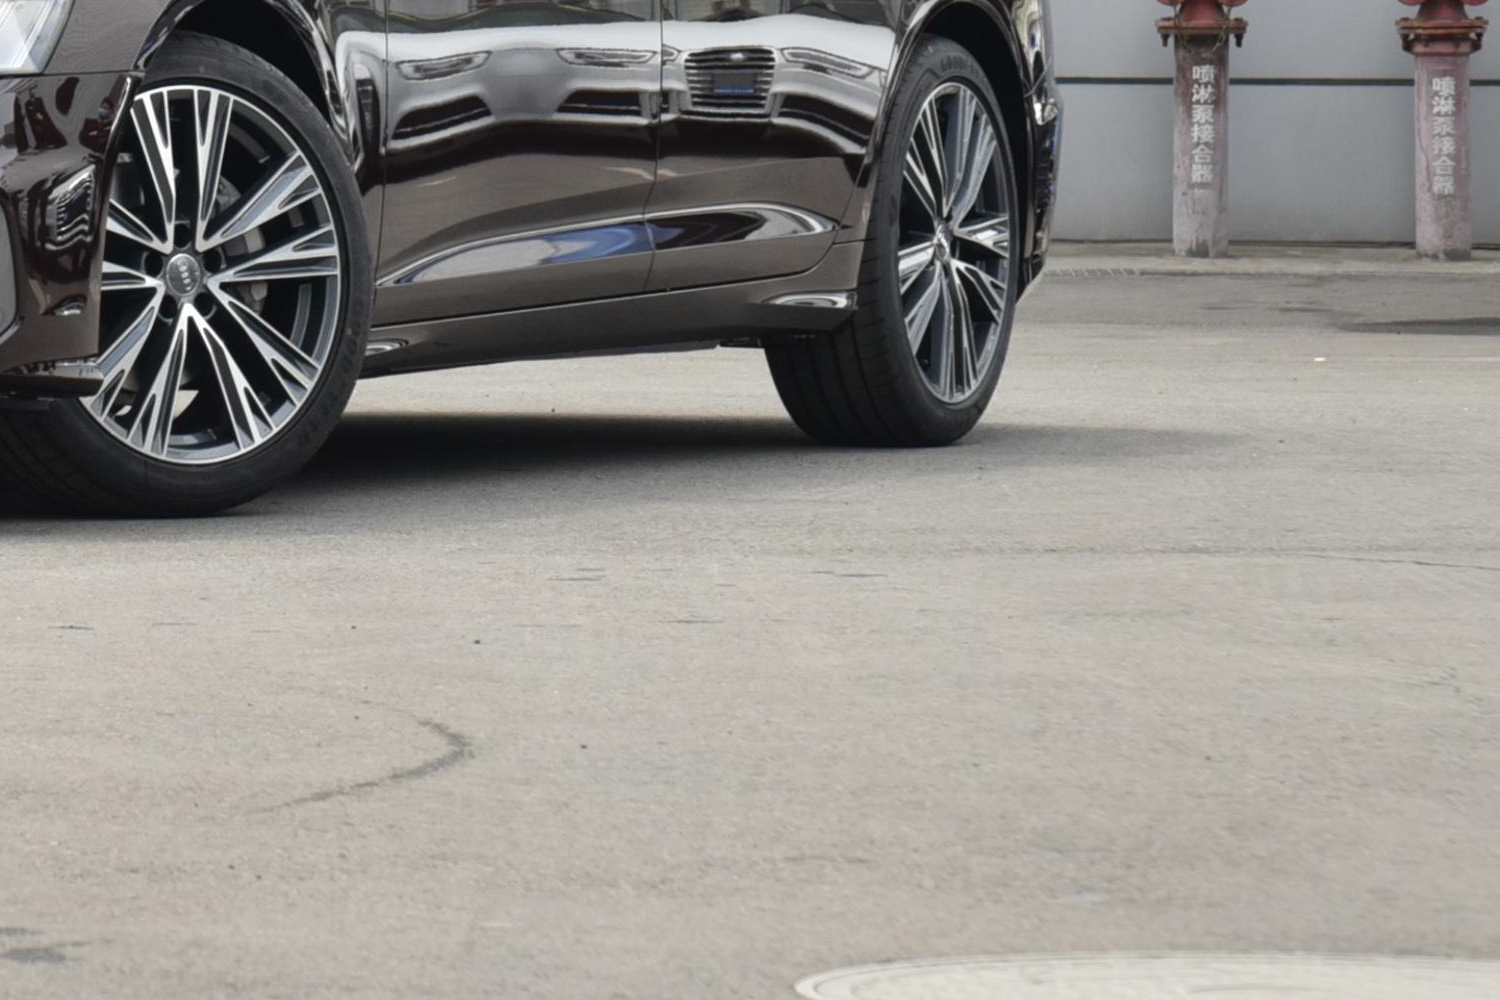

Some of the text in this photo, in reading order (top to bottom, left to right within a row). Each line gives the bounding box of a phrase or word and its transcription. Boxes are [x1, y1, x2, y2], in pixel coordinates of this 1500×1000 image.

[1190, 64, 1216, 184] 喷淋泵接合器
[1431, 76, 1456, 196] 喷淋泵接合器
